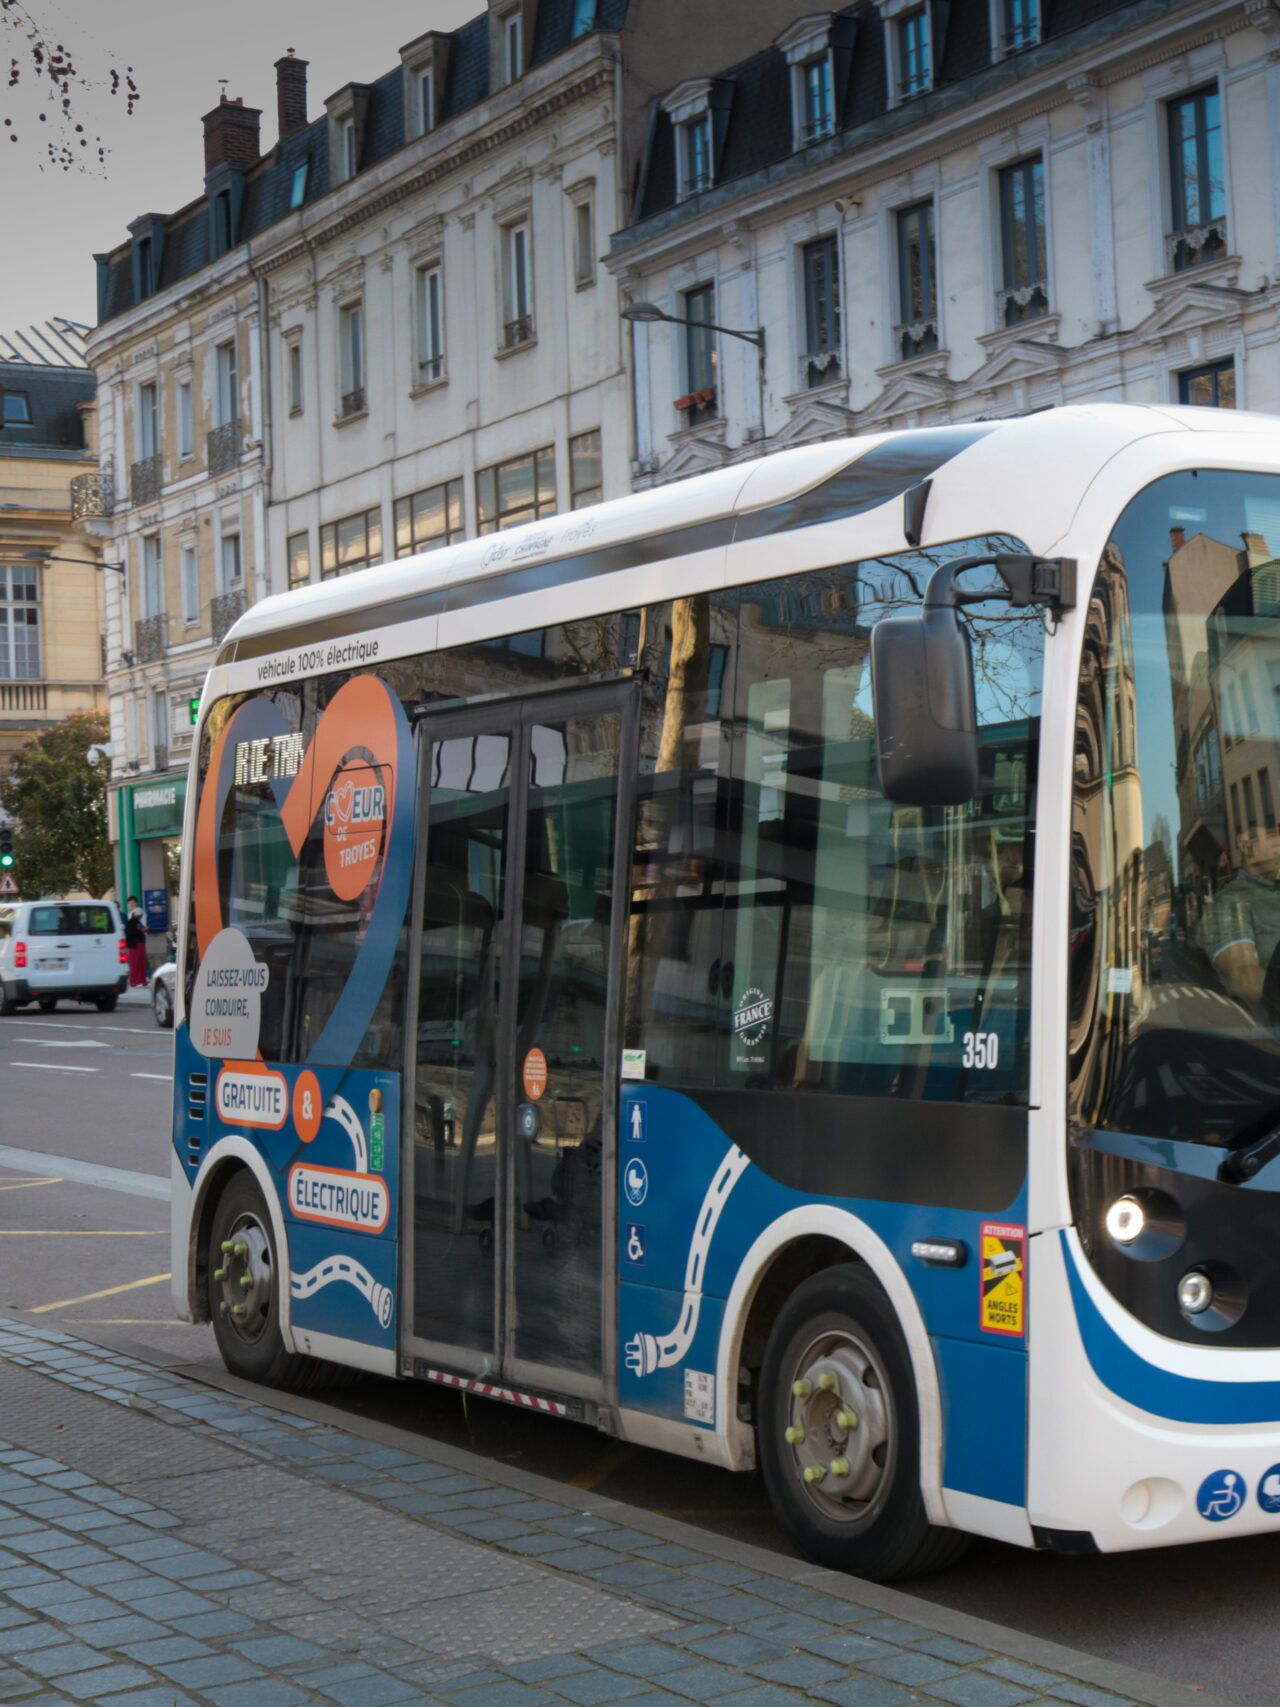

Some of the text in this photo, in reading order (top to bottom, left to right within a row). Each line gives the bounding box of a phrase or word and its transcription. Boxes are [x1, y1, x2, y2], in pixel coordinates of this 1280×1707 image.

[257, 640, 379, 680] véhicule 100% électrique
[133, 787, 176, 809] PHARMACIE
[336, 826, 348, 842] DE
[340, 838, 376, 868] TROYES
[207, 968, 266, 987] LAISSEZ-VOUS
[205, 998, 250, 1019] CONDUIRE,
[735, 1001, 771, 1028] FRANCE
[203, 1027, 232, 1047] JE SUIS
[962, 1031, 999, 1070] 350
[222, 1082, 281, 1113] GRATUITE
[302, 1090, 313, 1120] &
[296, 1170, 380, 1221] ÉLECTRIQUE
[983, 1225, 1024, 1239] ATTENTION
[988, 1299, 1018, 1313] ANGLES
[988, 1312, 1017, 1326] MORTS
